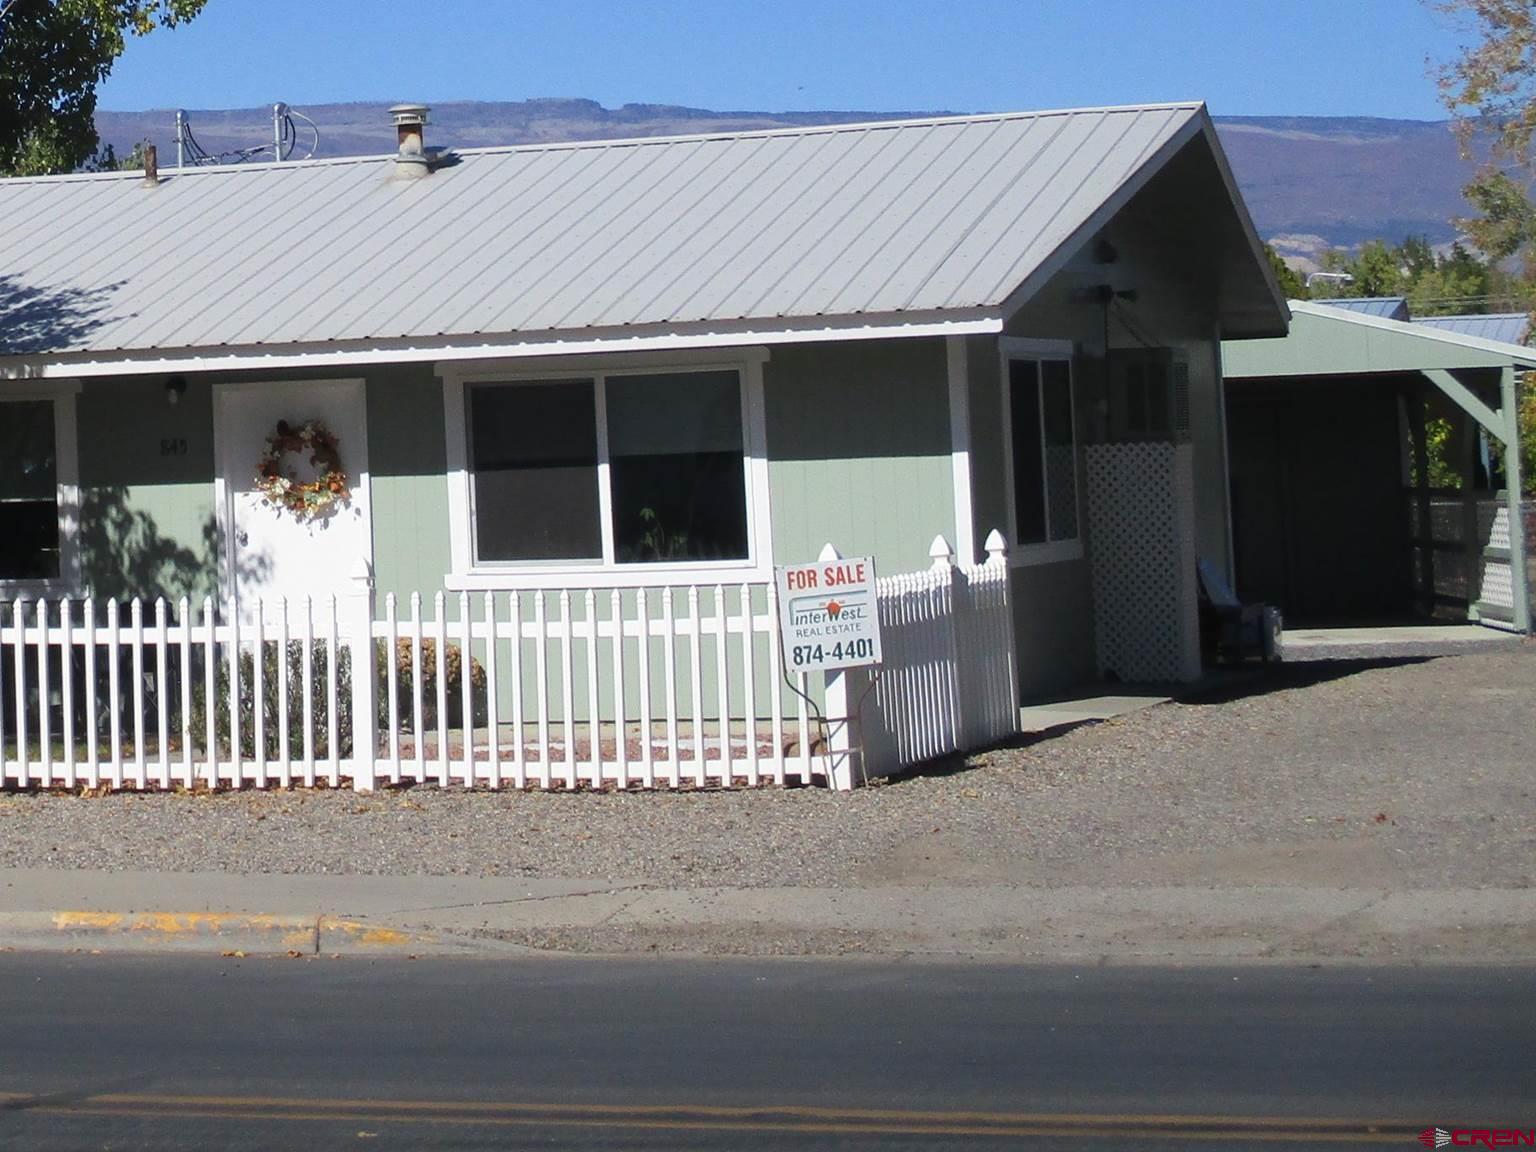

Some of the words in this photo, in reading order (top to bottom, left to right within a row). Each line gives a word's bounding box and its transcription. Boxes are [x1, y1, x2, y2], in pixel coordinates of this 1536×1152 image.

[787, 569, 818, 590] FOR
[824, 564, 866, 587] SALE
[796, 627, 823, 638] REAL
[825, 622, 862, 635] ESTATE
[793, 638, 874, 666] 874-4401
